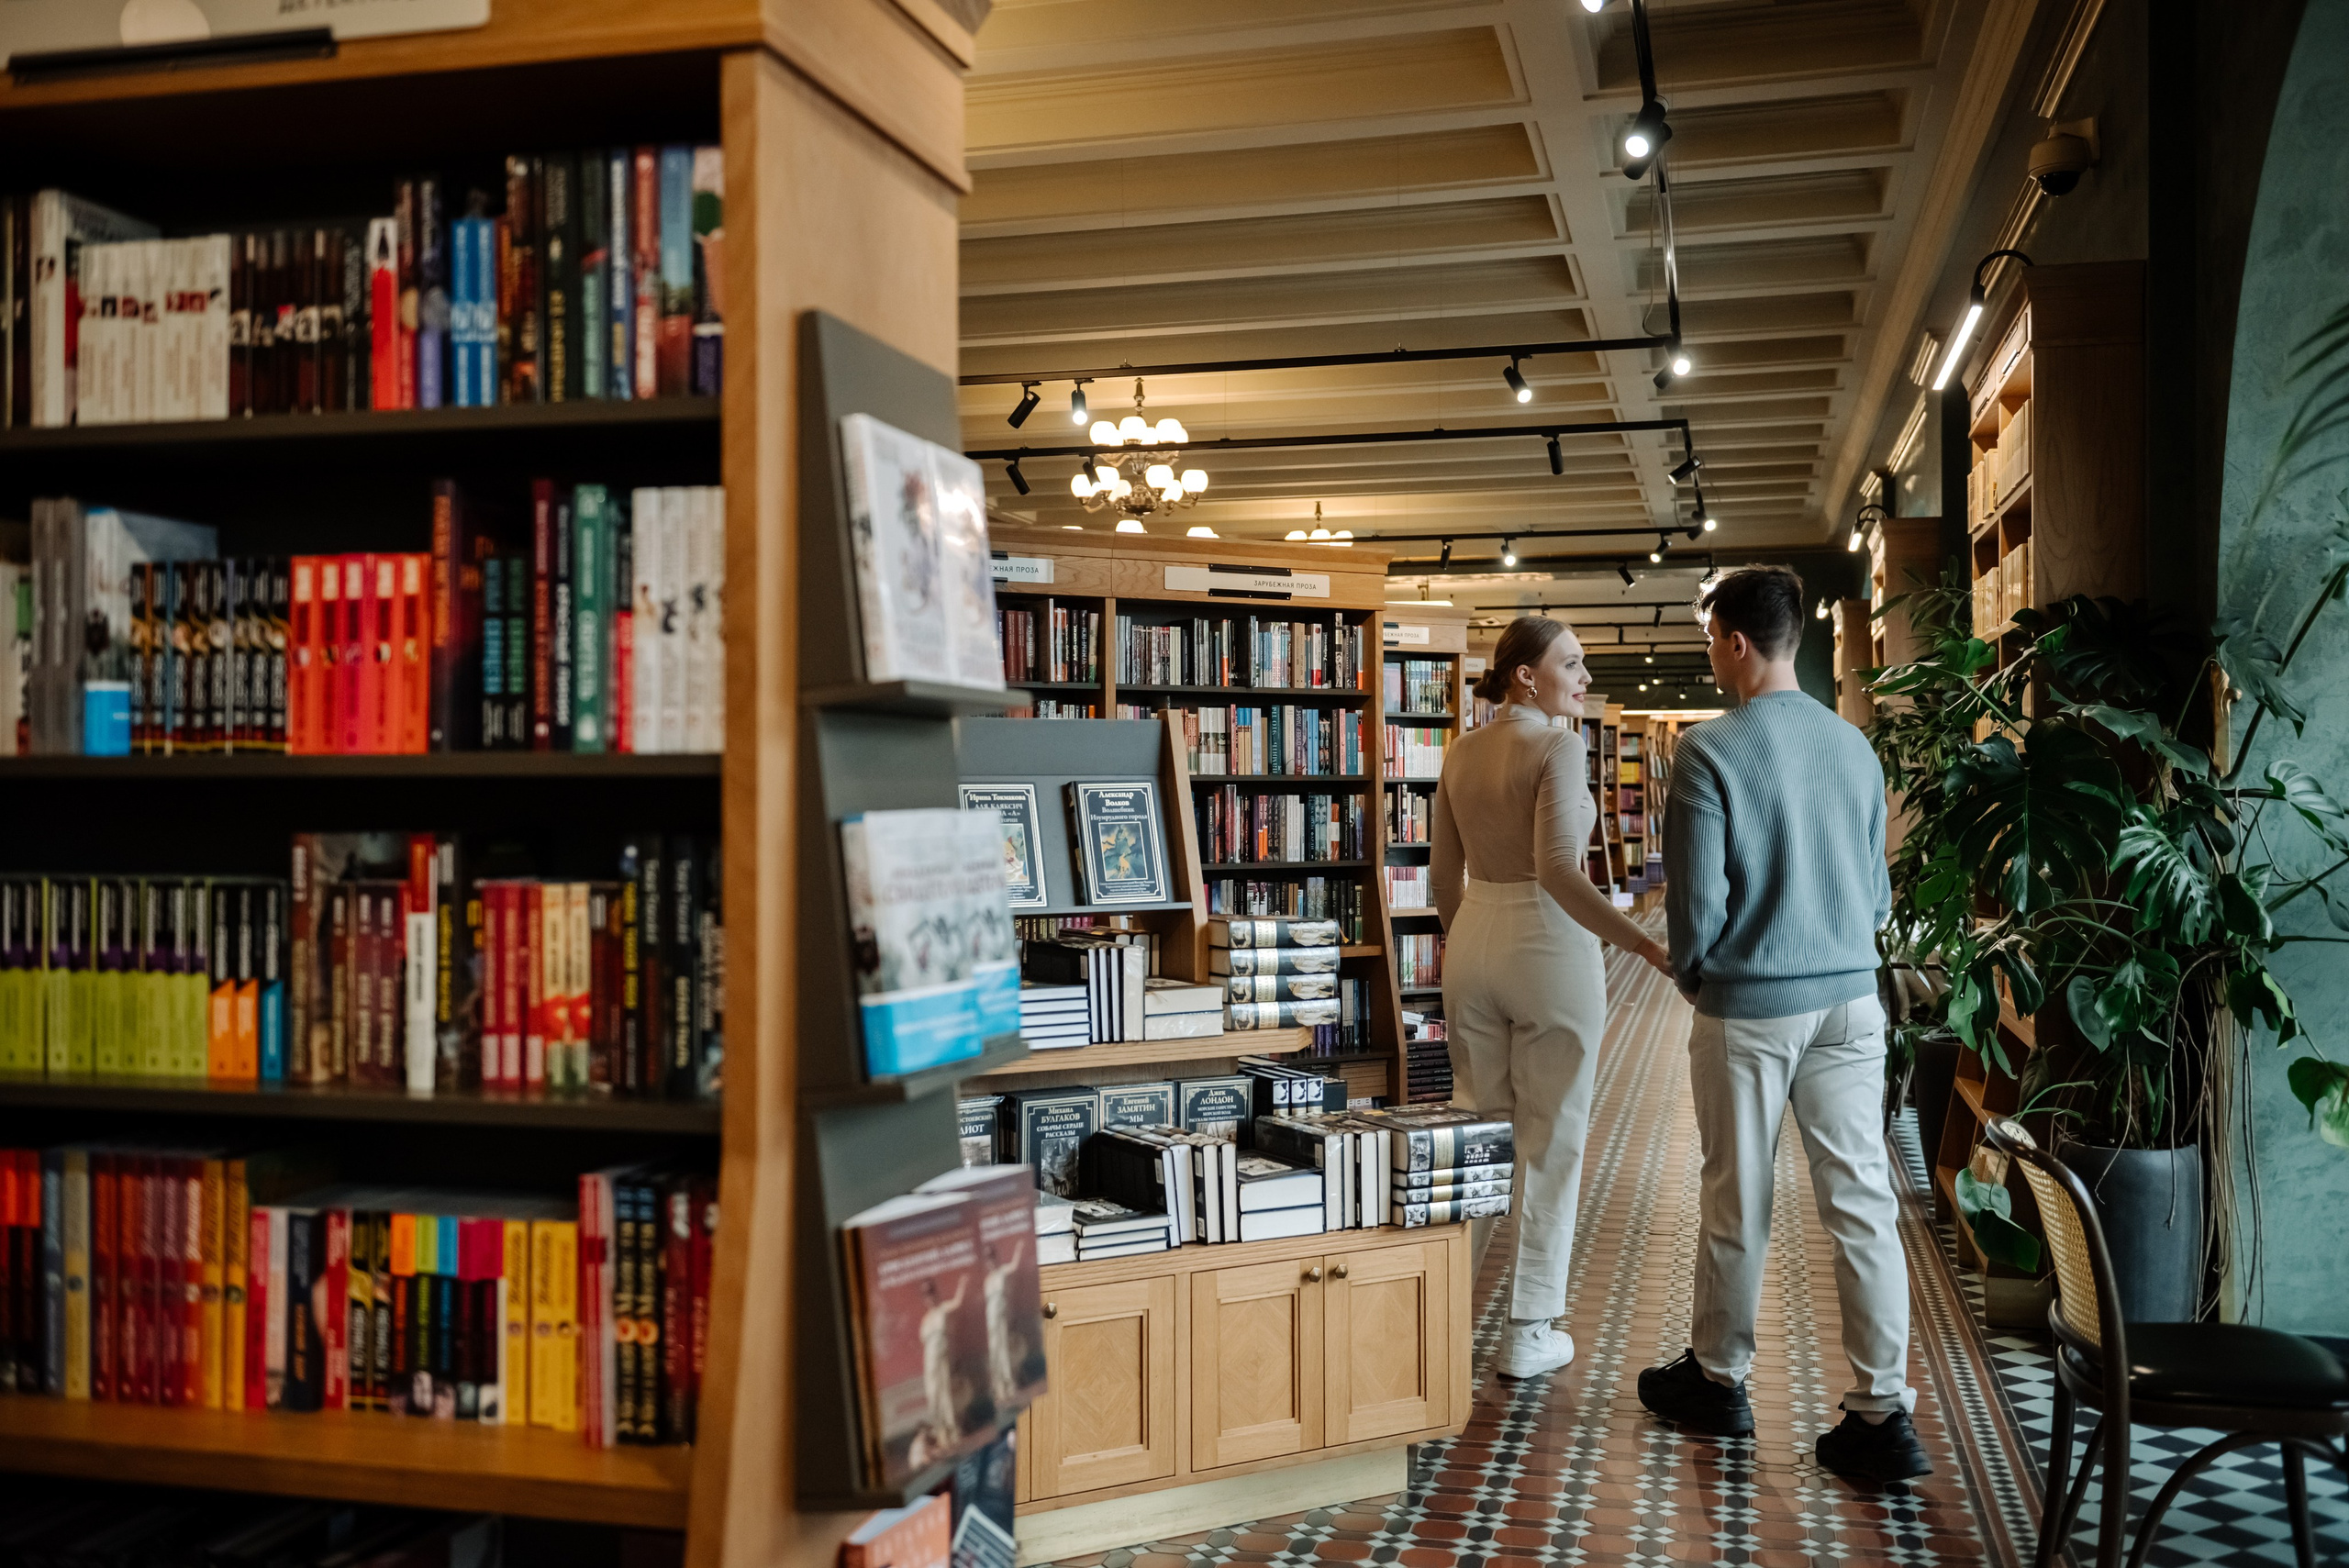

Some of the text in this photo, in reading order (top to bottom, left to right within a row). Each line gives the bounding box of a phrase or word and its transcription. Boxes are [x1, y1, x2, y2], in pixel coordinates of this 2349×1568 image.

[1253, 580, 1295, 589] ЗАРУБЕЖНАЯ
[969, 794, 991, 803] Ирина
[1208, 1089, 1226, 1097] Джек
[1123, 1096, 1150, 1106] Евгений
[1200, 1095, 1234, 1105] ЛОНДОН
[1117, 1104, 1156, 1114] ЗАМЯТИН
[958, 1114, 993, 1123] ОСТОЕВСКИЙ
[1041, 1113, 1081, 1124] БУЛГАКОВ
[1129, 1114, 1144, 1123] МЫ
[959, 1123, 985, 1136] ДИОТ
[1045, 1129, 1076, 1139] РАССКАЗЫ
